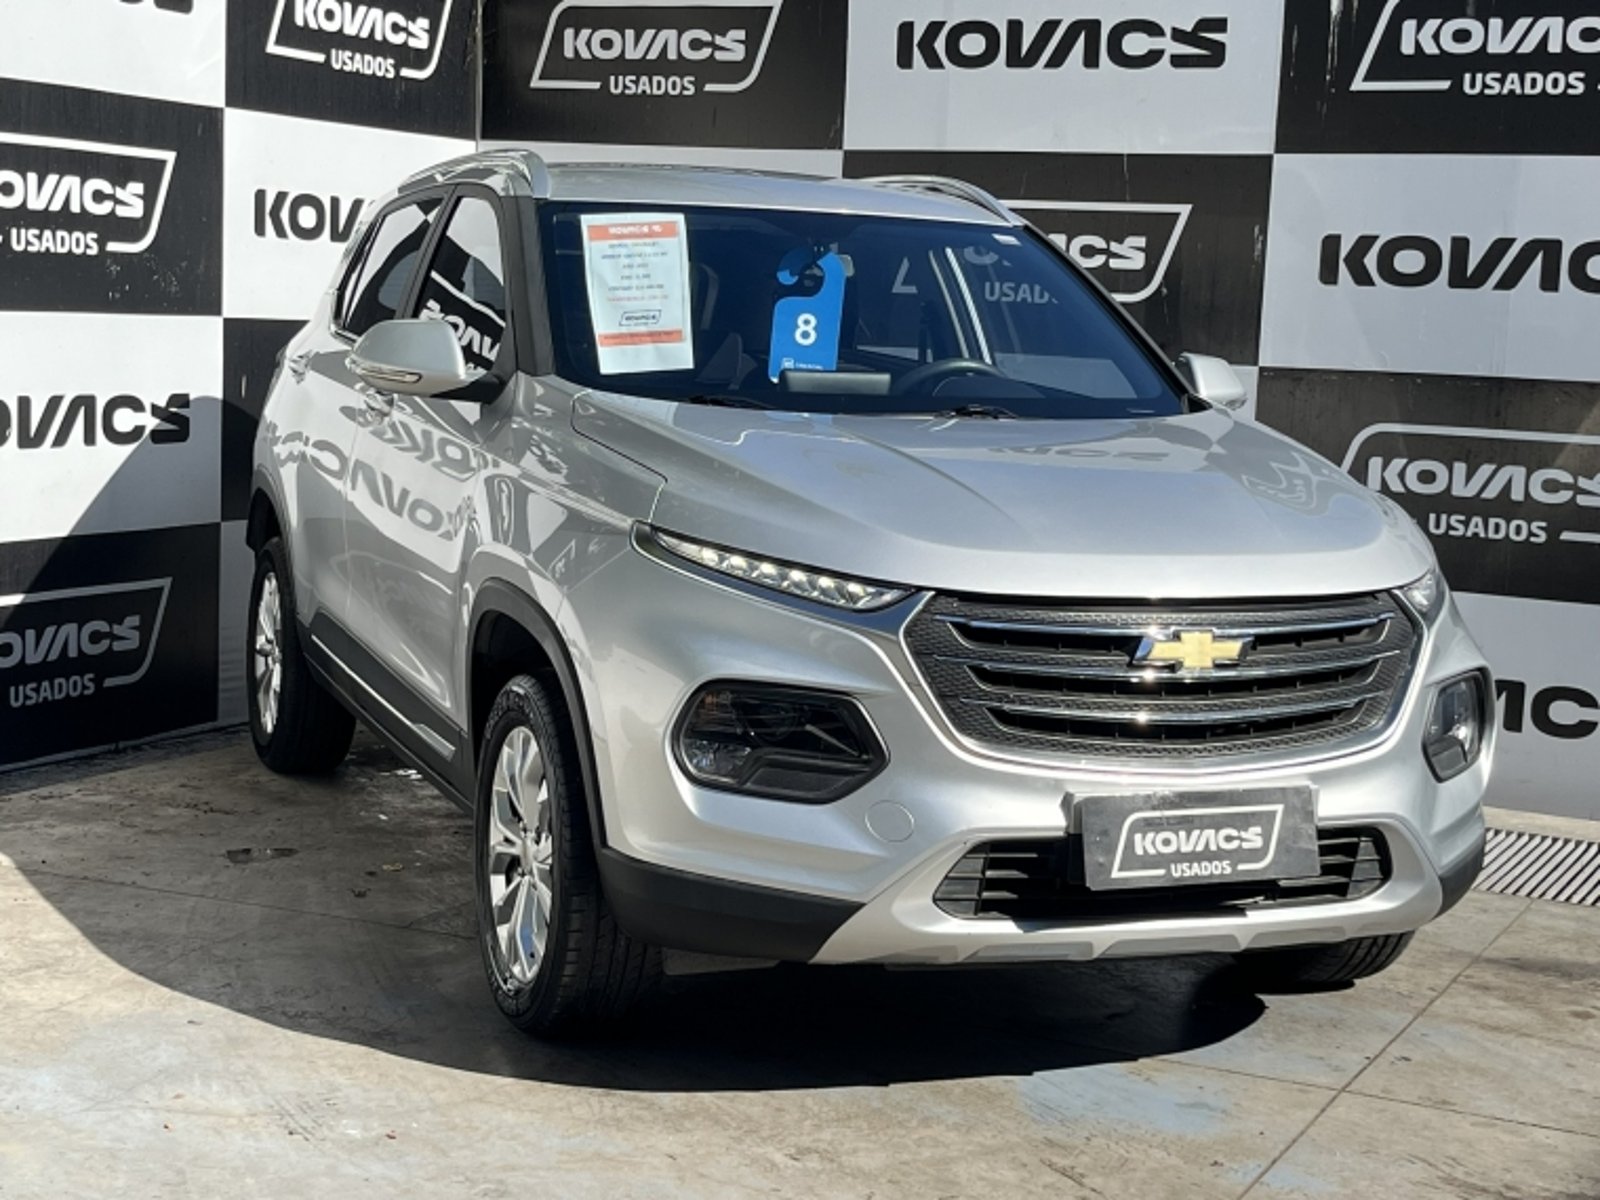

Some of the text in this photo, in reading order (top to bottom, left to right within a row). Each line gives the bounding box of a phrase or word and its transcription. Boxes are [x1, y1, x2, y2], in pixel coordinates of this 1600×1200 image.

[294, 0, 430, 49] KOVACS
[1401, 16, 1600, 55] KOVAC
[563, 27, 746, 61] KOVACS
[896, 16, 1228, 69] KOVACS
[331, 48, 395, 79] USADOS
[609, 75, 696, 95] USADOS
[1463, 72, 1585, 95] USADOS
[0, 169, 144, 219] OVACS
[254, 188, 365, 243] KOV
[10, 227, 99, 255] USADOS
[984, 281, 1052, 304] USAD
[794, 313, 817, 346] 8
[0, 393, 190, 449] VACS
[1428, 513, 1547, 543] USADOS
[0, 615, 140, 668] OVACS
[9, 673, 95, 708] USADOS
[1134, 826, 1263, 855] KOVACS
[1170, 861, 1232, 877] USADOS
